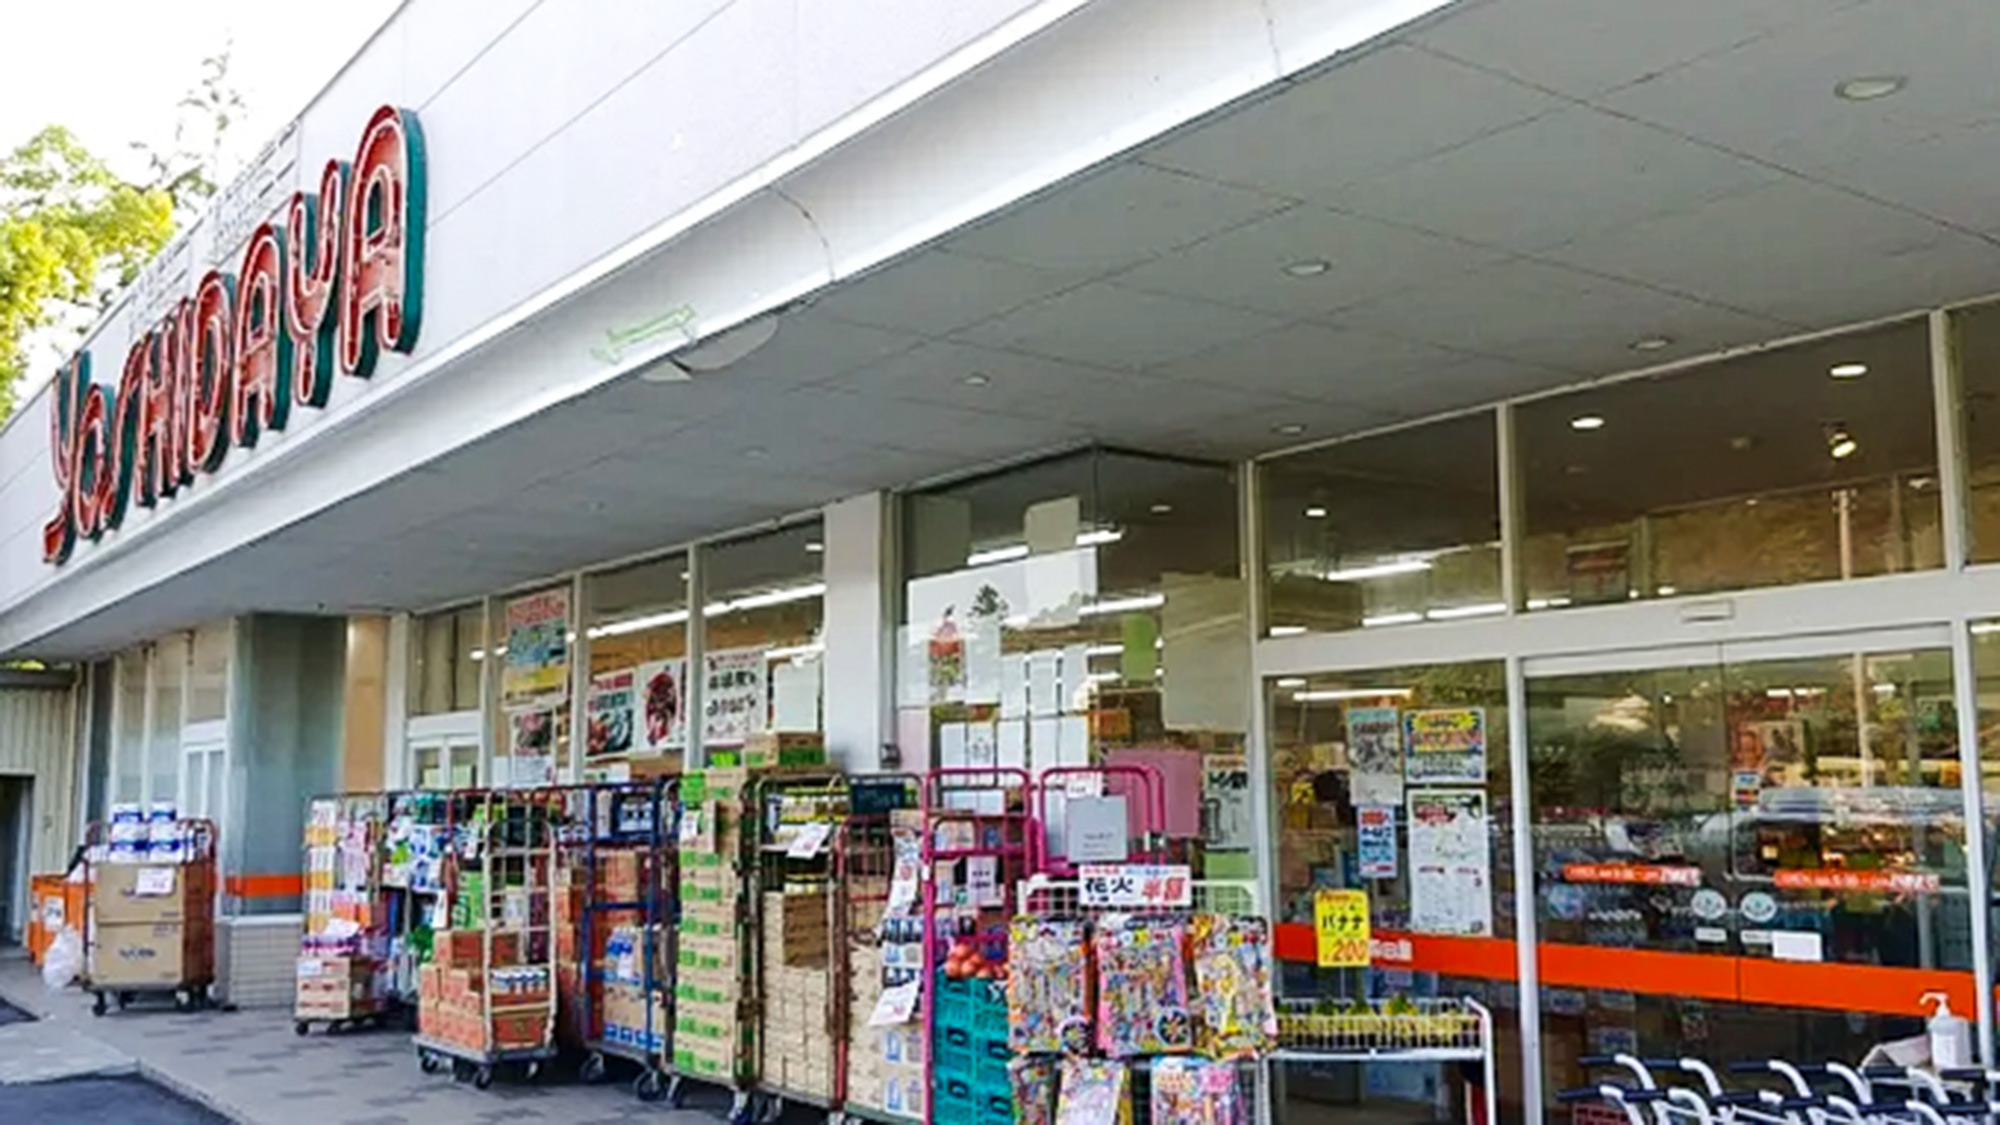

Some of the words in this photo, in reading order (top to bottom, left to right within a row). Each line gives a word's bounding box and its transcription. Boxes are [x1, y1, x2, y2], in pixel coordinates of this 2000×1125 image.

[1085, 876, 1133, 894] 花火
[1322, 914, 1363, 931] バナナ
